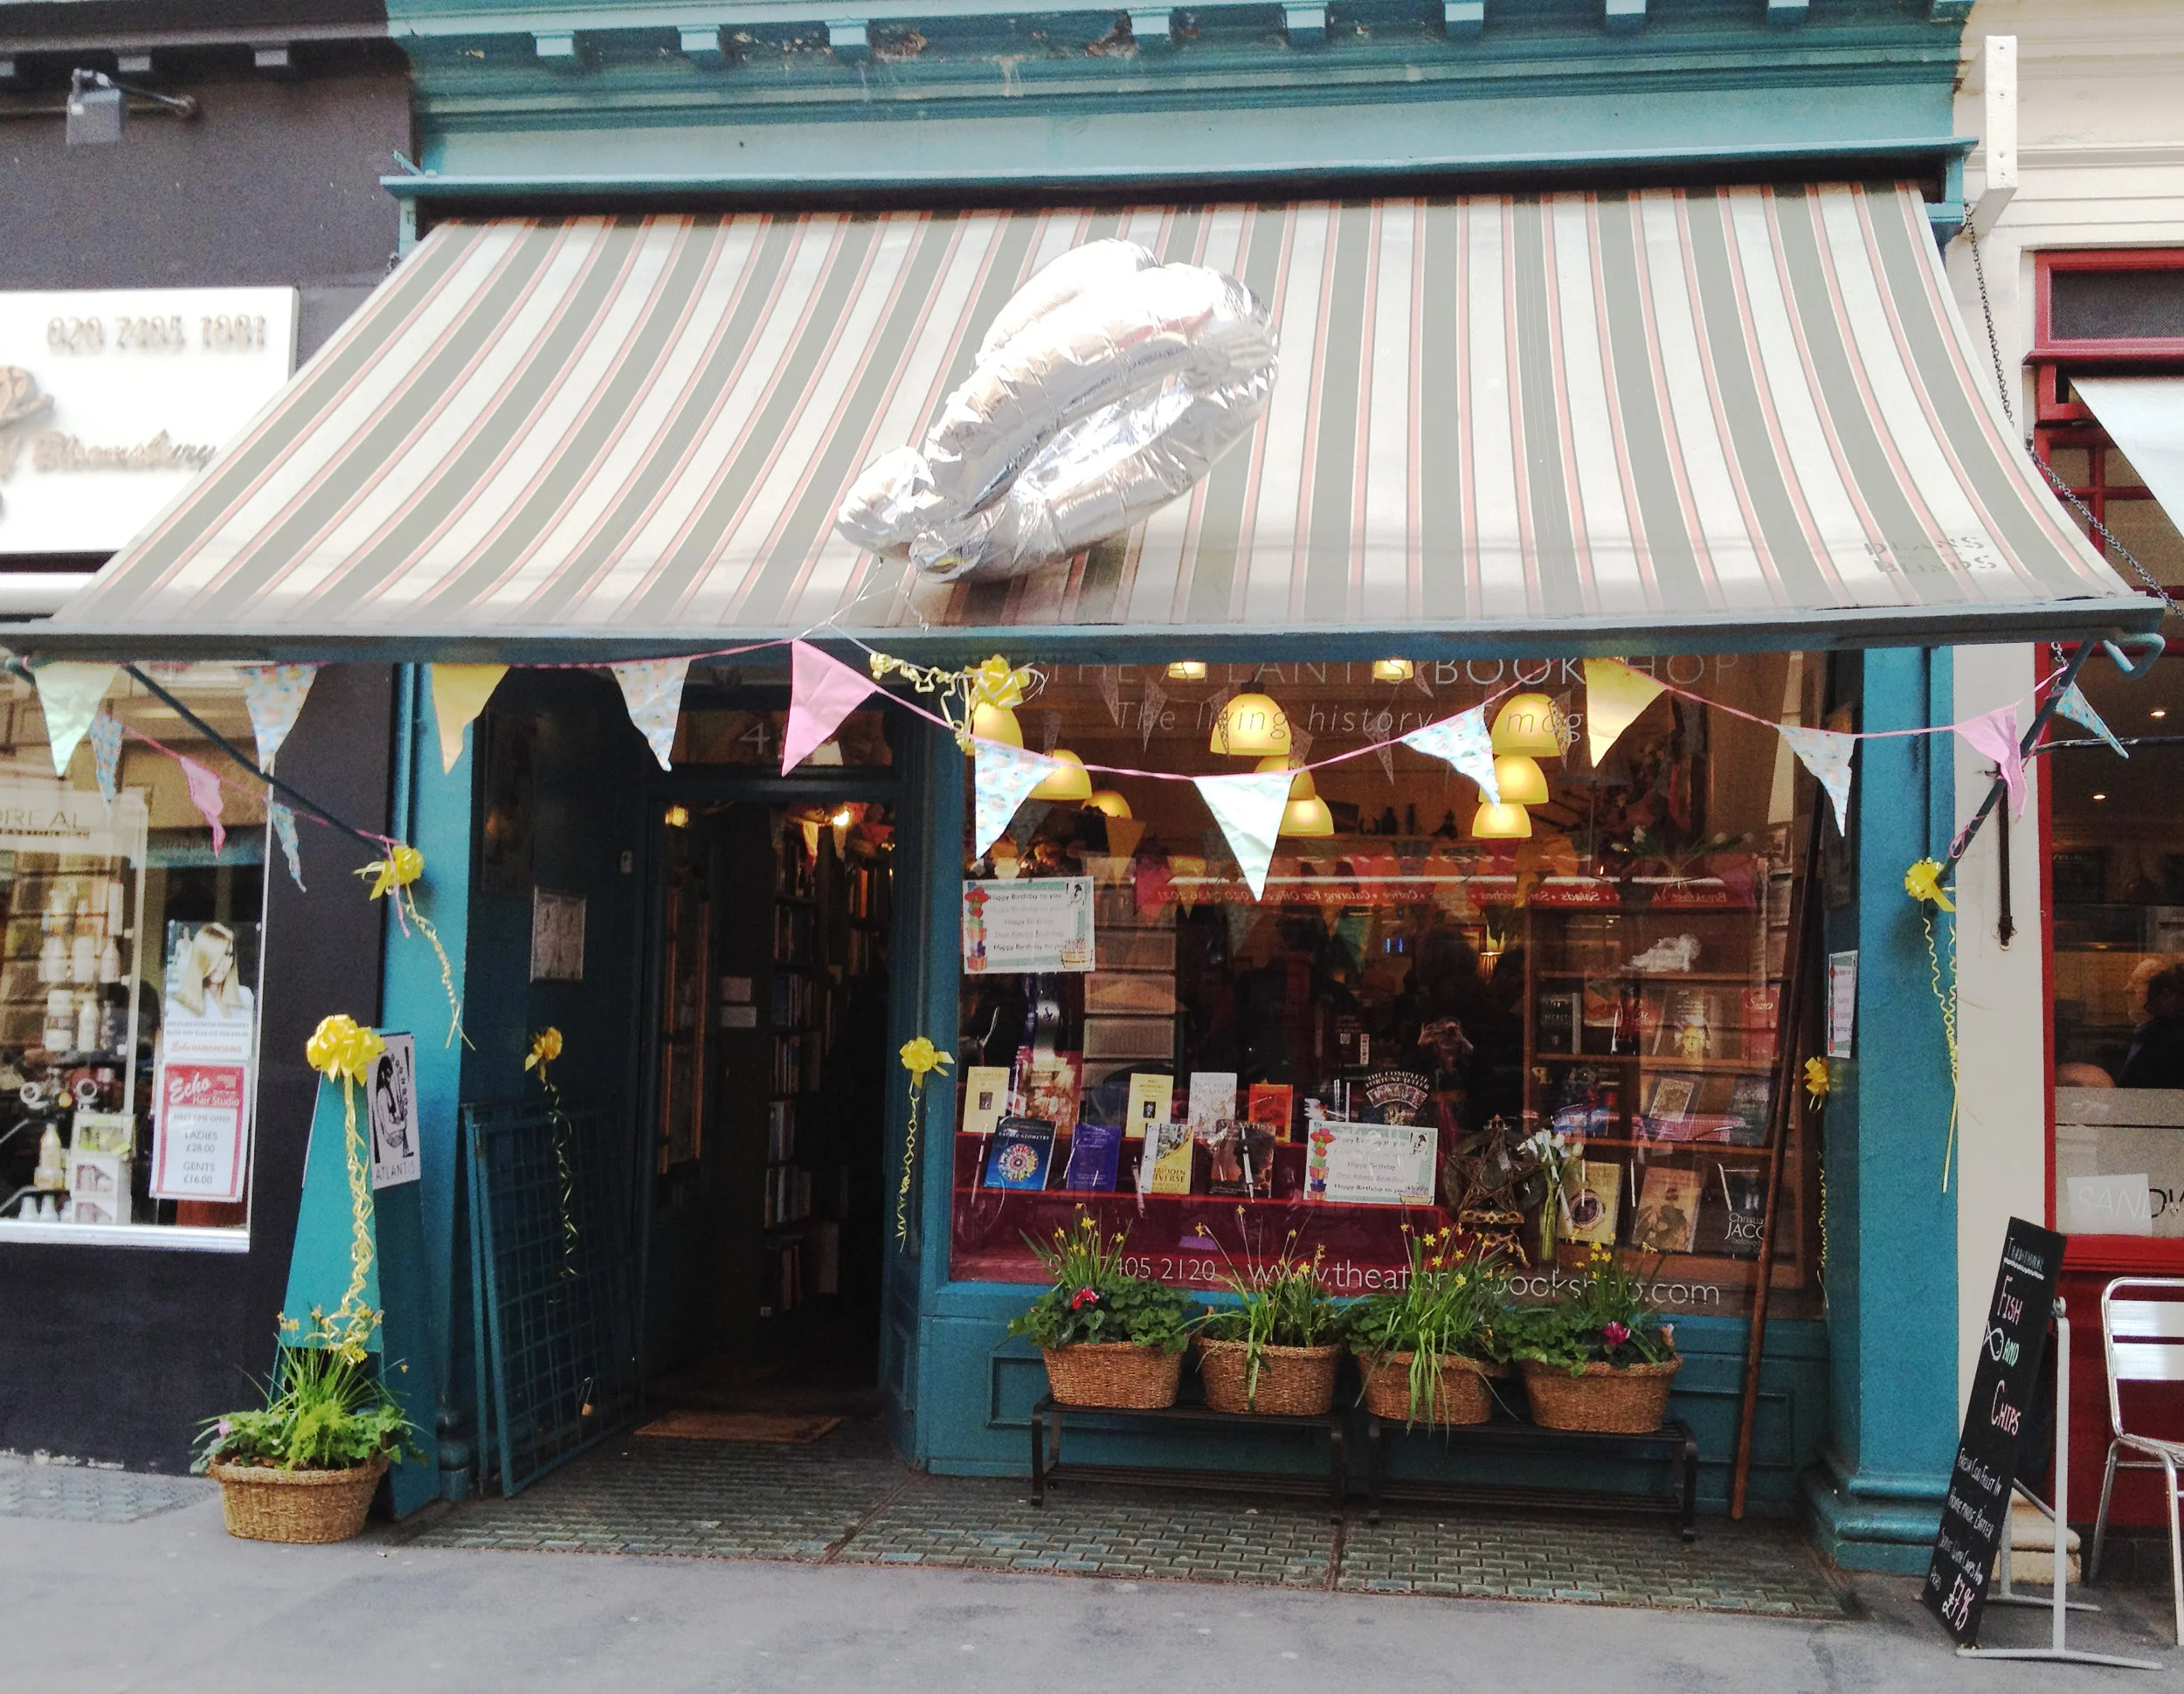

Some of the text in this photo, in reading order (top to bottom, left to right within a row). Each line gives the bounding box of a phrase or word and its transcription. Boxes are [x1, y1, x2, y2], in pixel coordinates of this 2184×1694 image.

[47, 315, 105, 351] 020
[1435, 654, 1738, 685] BOOKHOP
[1196, 701, 1289, 740] living
[1308, 703, 1434, 733] history
[169, 1071, 211, 1105] Echo
[192, 1095, 239, 1107] Hair Studio
[184, 1130, 218, 1141] LADIES
[186, 1143, 215, 1153] £28.00
[183, 1162, 216, 1172] GENTS
[376, 1160, 415, 1181] ATLANTIS
[183, 1174, 212, 1185] £16.00
[1356, 1184, 1383, 1193] Birthday
[1728, 1213, 1764, 1224] Christia
[1160, 1258, 1216, 1282] 2120
[1996, 1276, 2023, 1325] FISH
[2002, 1337, 2021, 1367] AND
[1991, 1379, 2022, 1436] CHIPS
